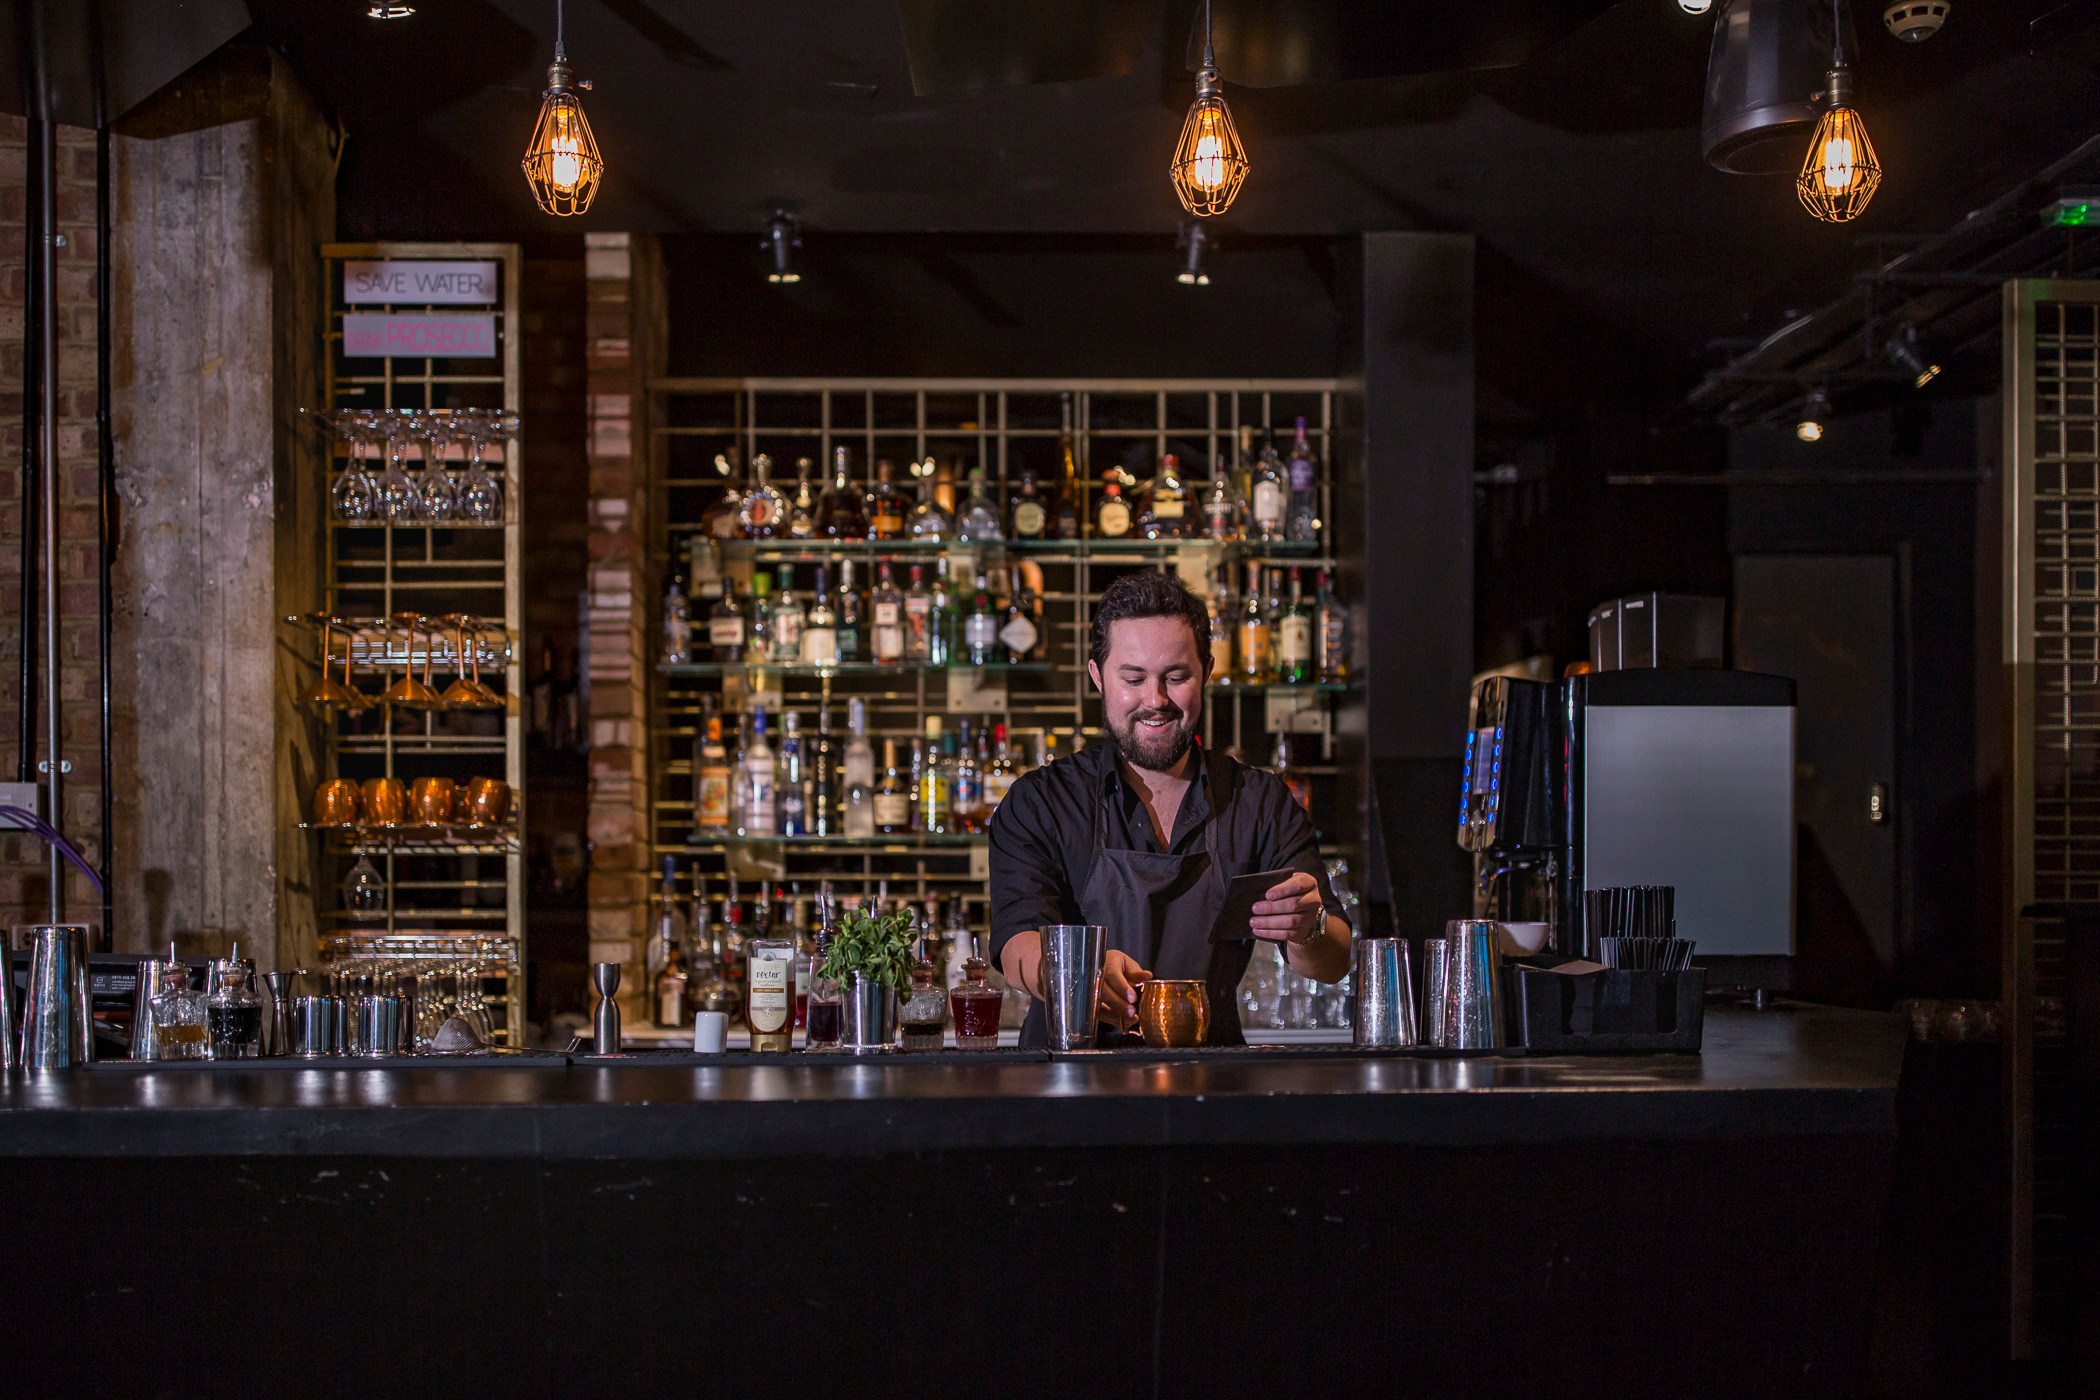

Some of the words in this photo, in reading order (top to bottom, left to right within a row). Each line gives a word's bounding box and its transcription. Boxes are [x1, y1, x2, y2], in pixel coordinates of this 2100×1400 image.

[355, 271, 408, 294] SAVE
[414, 272, 486, 295] WATER
[387, 322, 492, 352] PROSECCO
